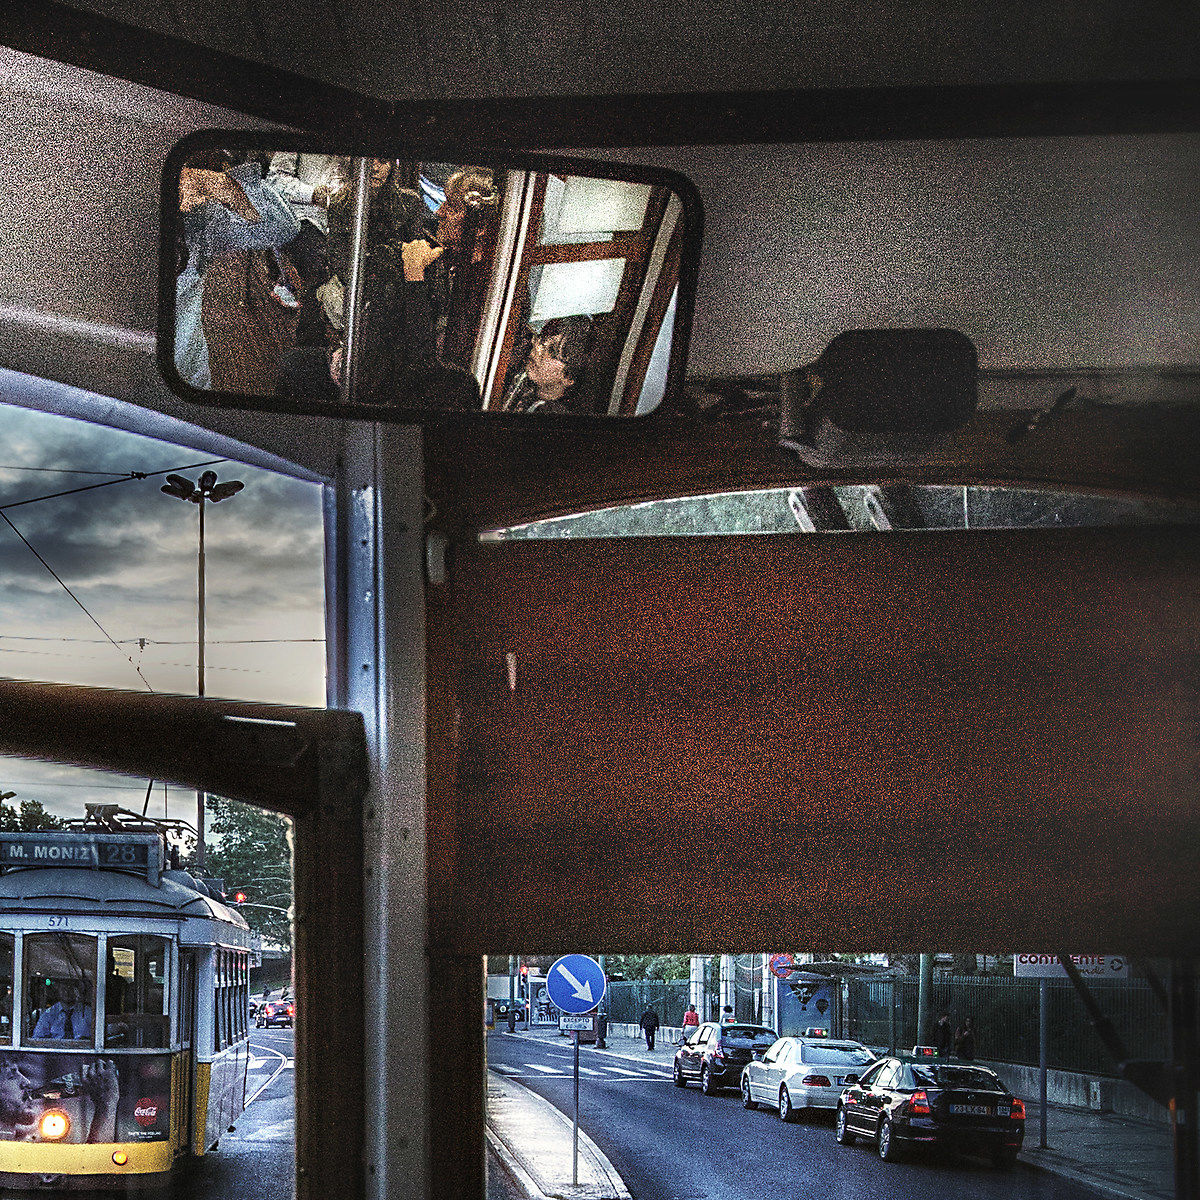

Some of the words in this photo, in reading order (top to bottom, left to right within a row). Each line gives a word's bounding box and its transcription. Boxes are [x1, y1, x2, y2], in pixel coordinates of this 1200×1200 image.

[9, 845, 29, 858] M.
[34, 846, 90, 860] MONIZ
[106, 844, 136, 862] 28
[48, 916, 69, 927] 571
